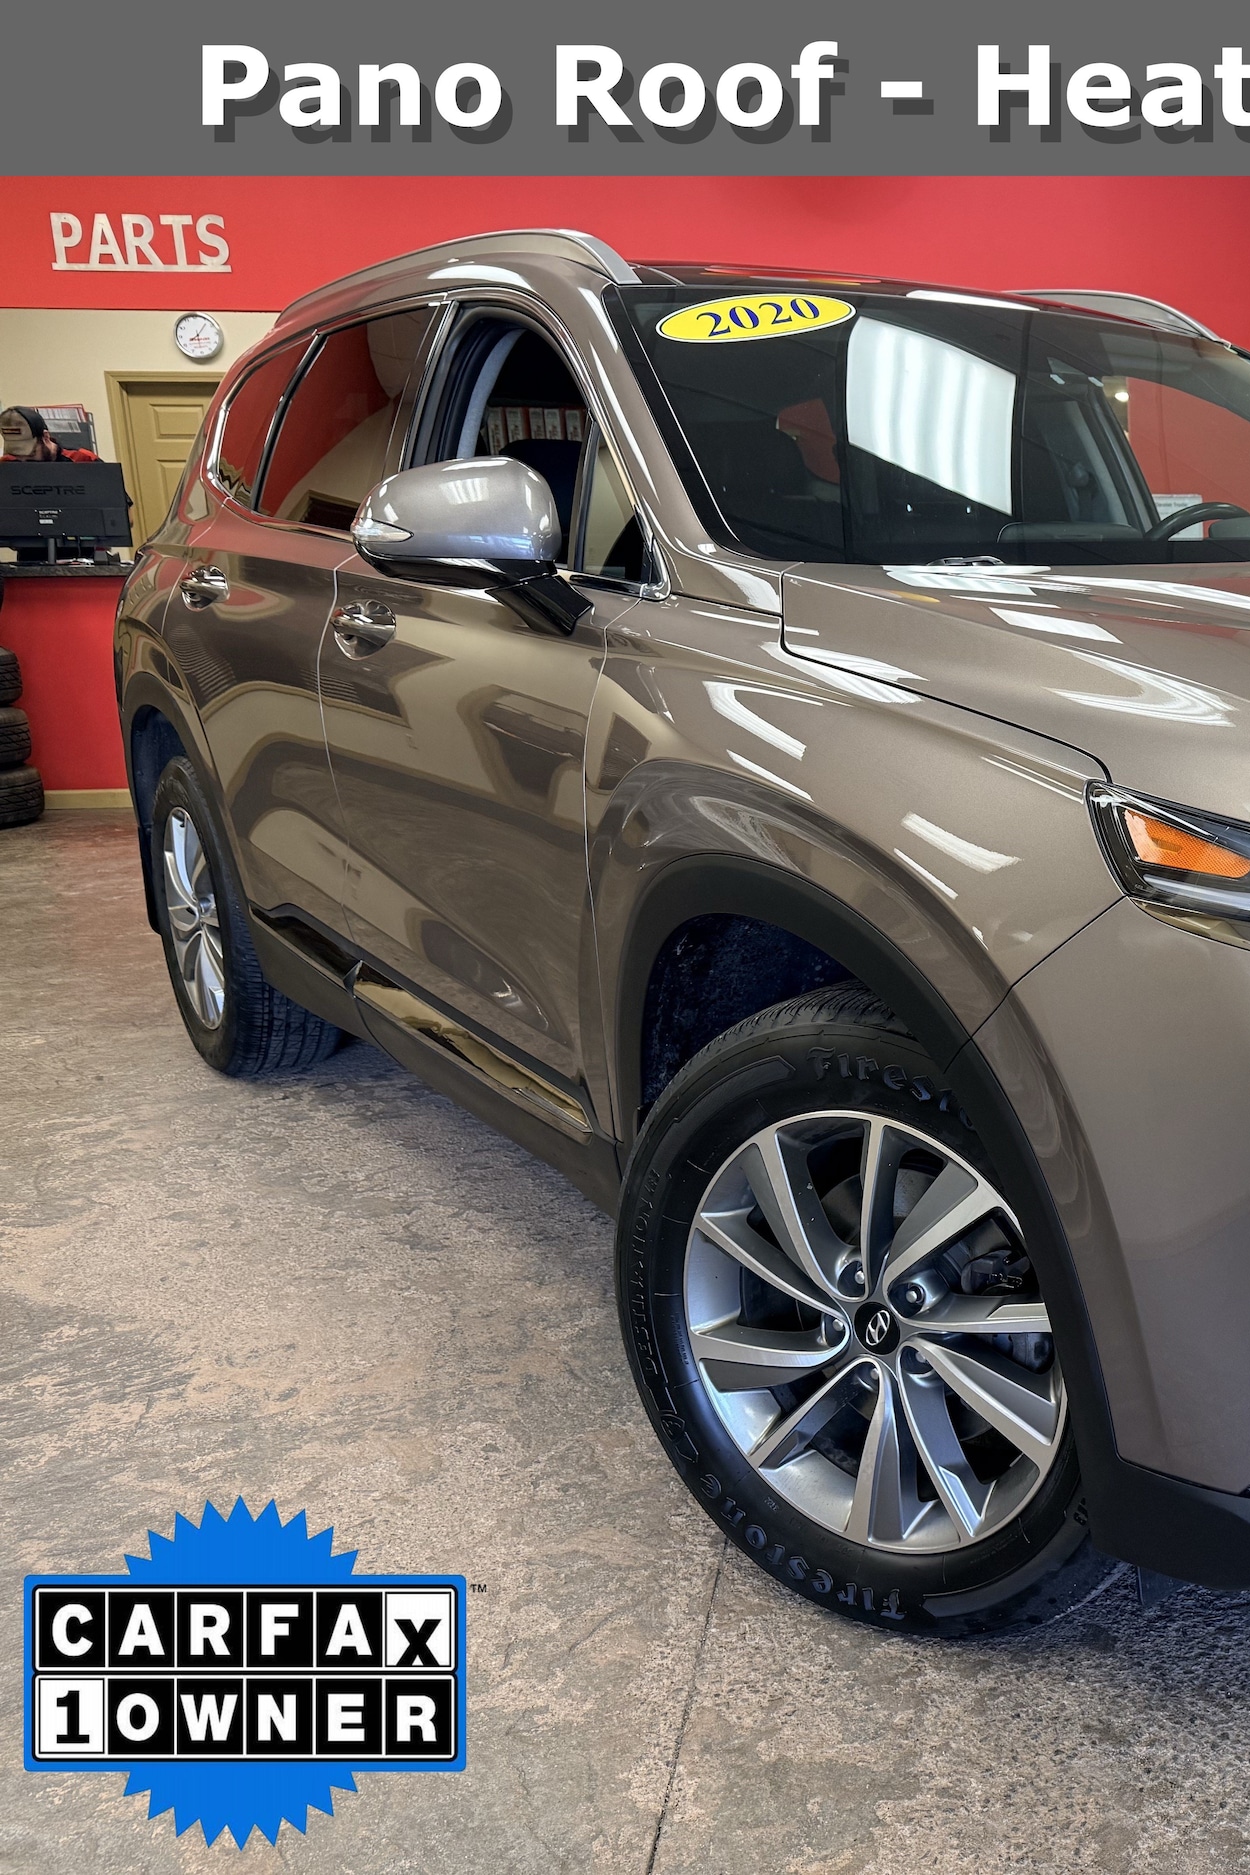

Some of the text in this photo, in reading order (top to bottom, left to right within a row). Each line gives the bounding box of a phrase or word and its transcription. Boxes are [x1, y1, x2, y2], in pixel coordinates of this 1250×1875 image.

[50, 212, 231, 270] PARTS
[696, 298, 820, 337] 2020
[10, 485, 86, 495] SCEPTRE
[807, 1046, 976, 1132] Firest
[701, 1473, 907, 1620] Firestone
